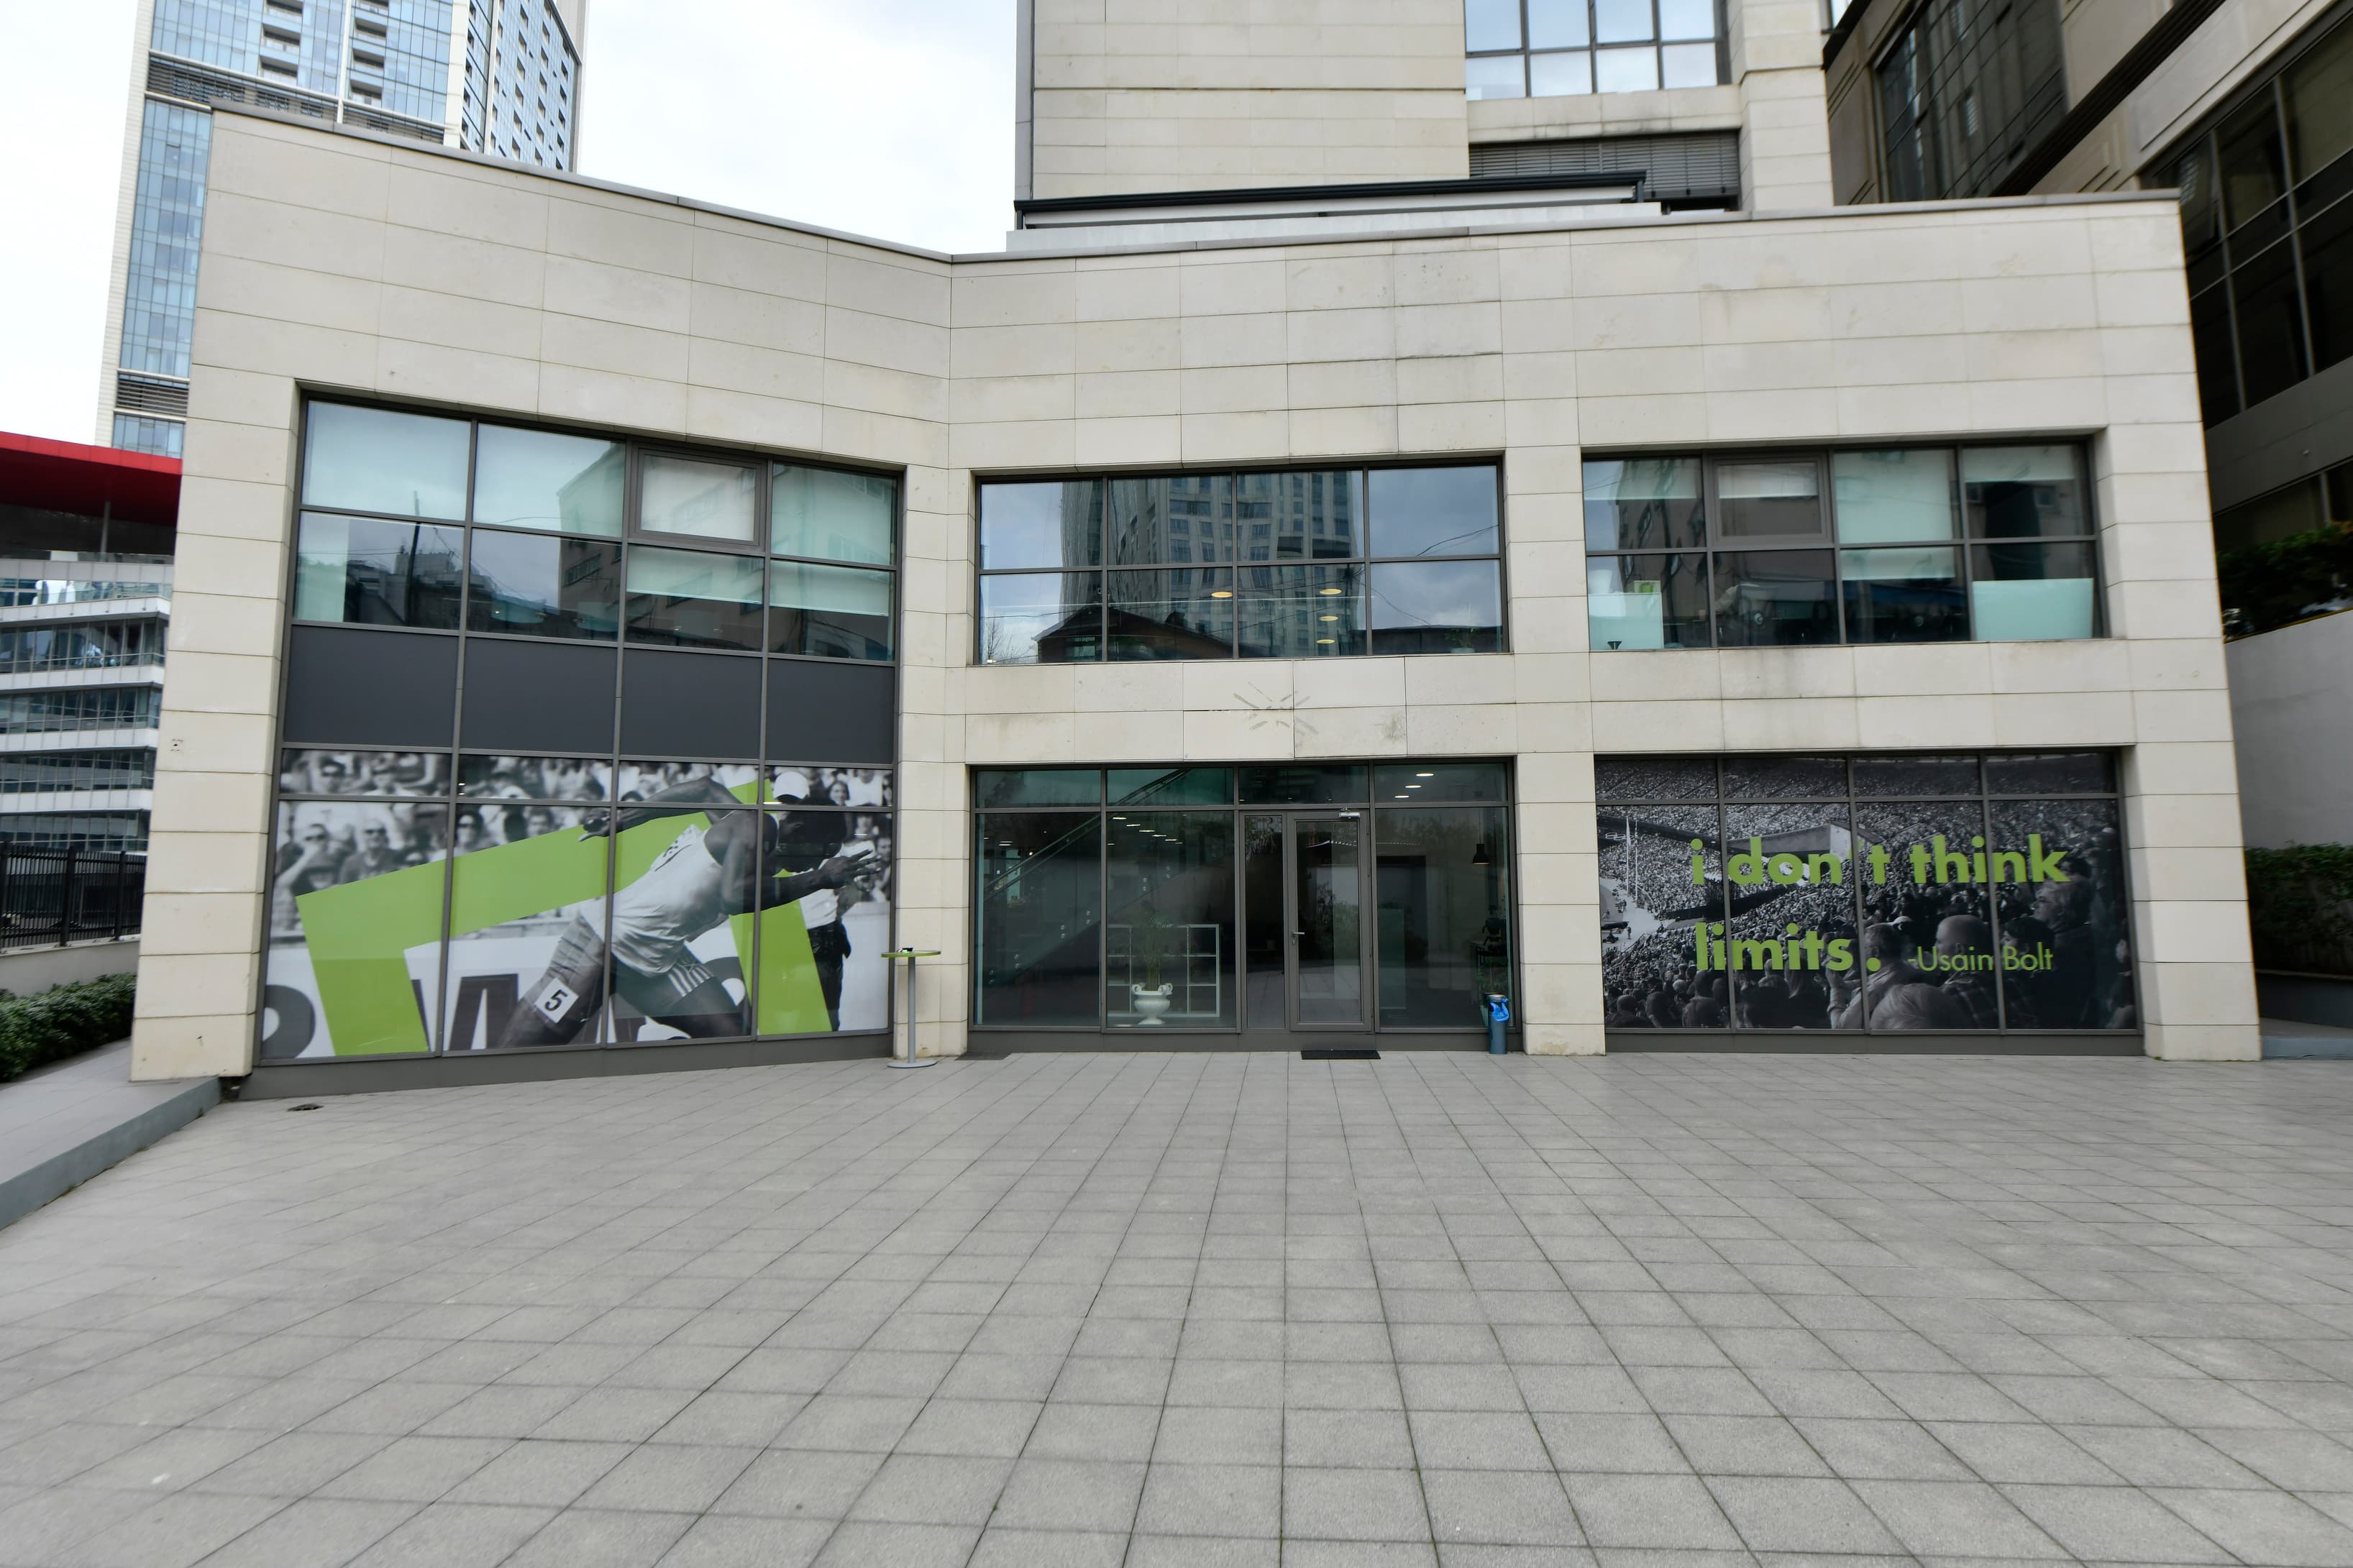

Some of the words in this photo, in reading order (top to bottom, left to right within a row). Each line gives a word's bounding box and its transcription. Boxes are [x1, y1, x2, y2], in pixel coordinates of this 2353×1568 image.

[1691, 838, 1705, 884] i
[1910, 834, 2070, 884] think
[1695, 922, 1881, 971] limits.
[2003, 942, 2054, 971] Bolt
[544, 989, 568, 1012] 5
